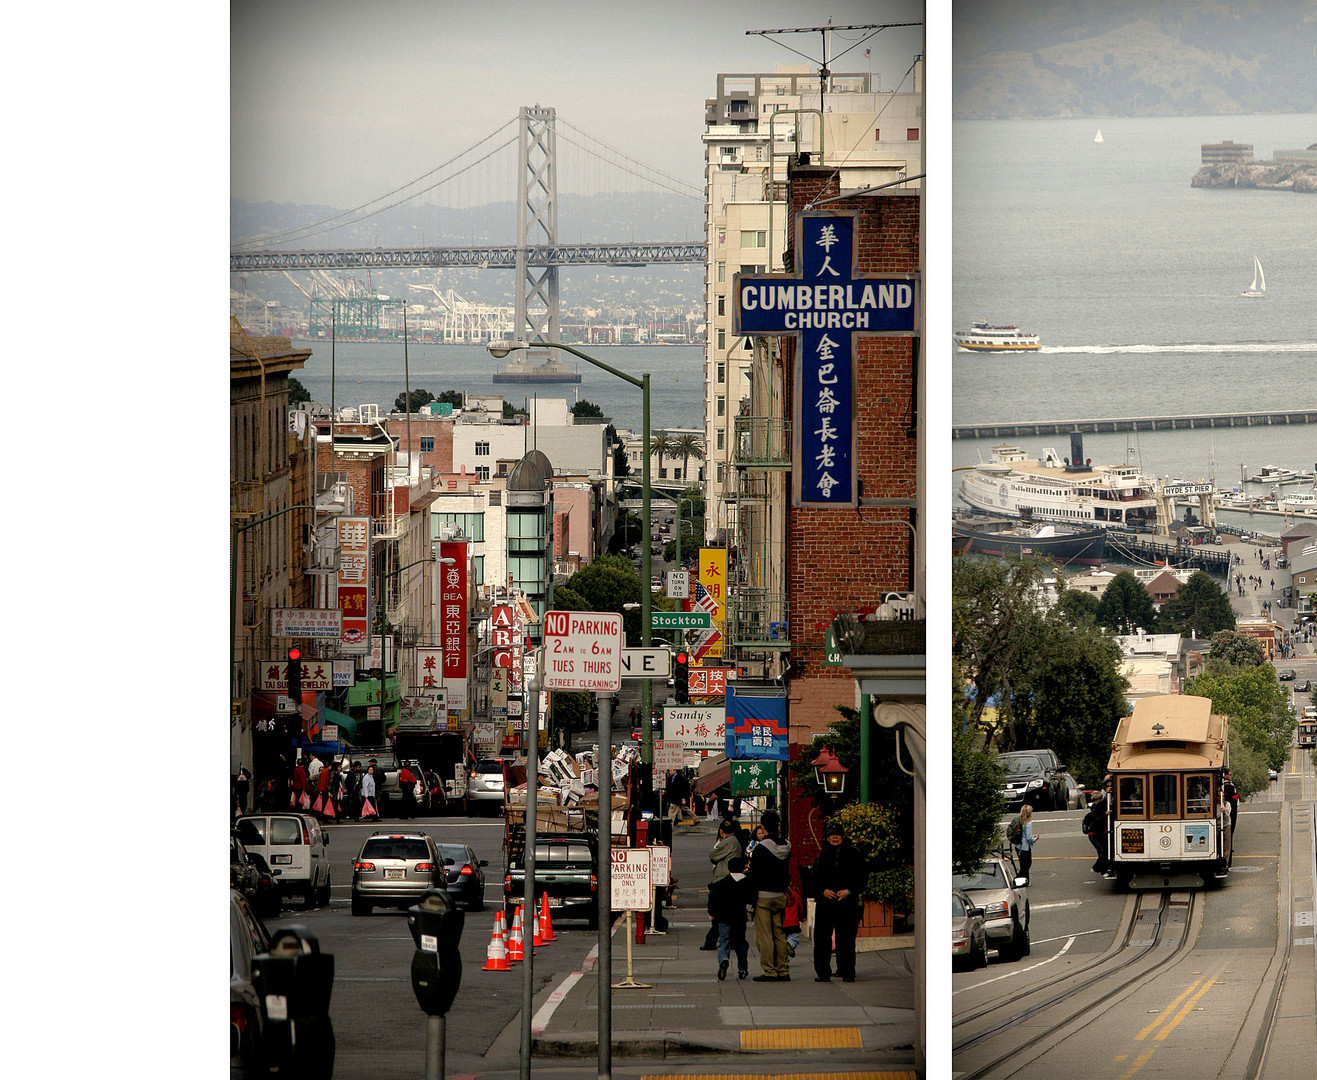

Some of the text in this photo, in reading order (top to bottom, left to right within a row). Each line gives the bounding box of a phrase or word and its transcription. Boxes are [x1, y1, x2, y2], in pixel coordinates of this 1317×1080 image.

[815, 224, 840, 277] 華人
[741, 284, 912, 310] CUMBERLAND
[784, 311, 869, 329] CHURCH
[547, 615, 617, 635] NO PARKING
[651, 616, 704, 625] Stockton
[445, 605, 460, 667] 東亞銀行
[553, 660, 611, 673] TUES THURS
[301, 681, 330, 689] EWELRY
[549, 679, 575, 687] STREET
[710, 683, 723, 693] 大
[670, 711, 712, 722] Sandy's
[611, 851, 625, 861] NO
[611, 864, 648, 872] PARKING
